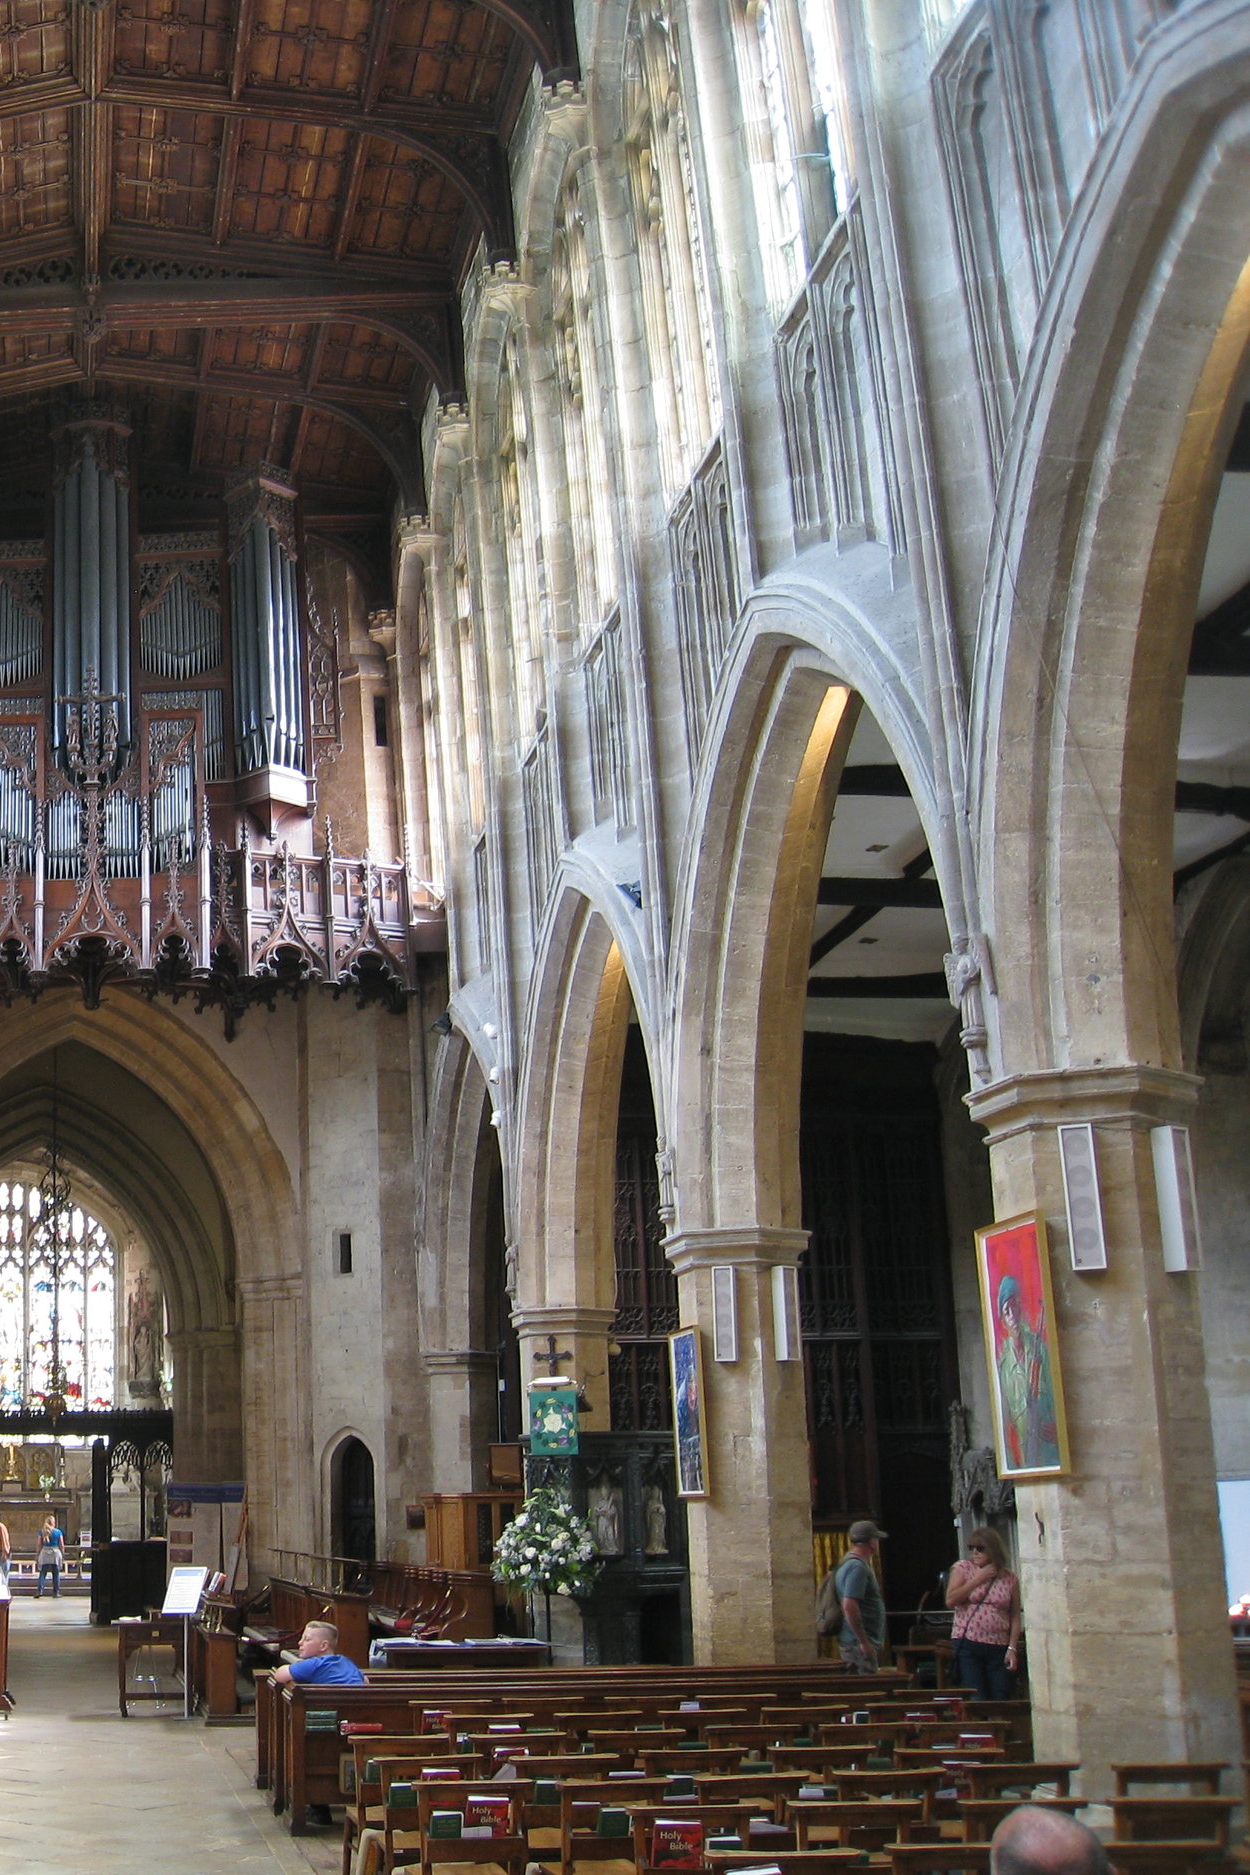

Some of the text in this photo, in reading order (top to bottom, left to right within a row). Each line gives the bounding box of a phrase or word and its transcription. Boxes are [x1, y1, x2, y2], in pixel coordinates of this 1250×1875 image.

[472, 1806, 492, 1815] Holy
[480, 1815, 502, 1823] Bible
[660, 1831, 682, 1841] Holy
[670, 1842, 693, 1850] Bible
